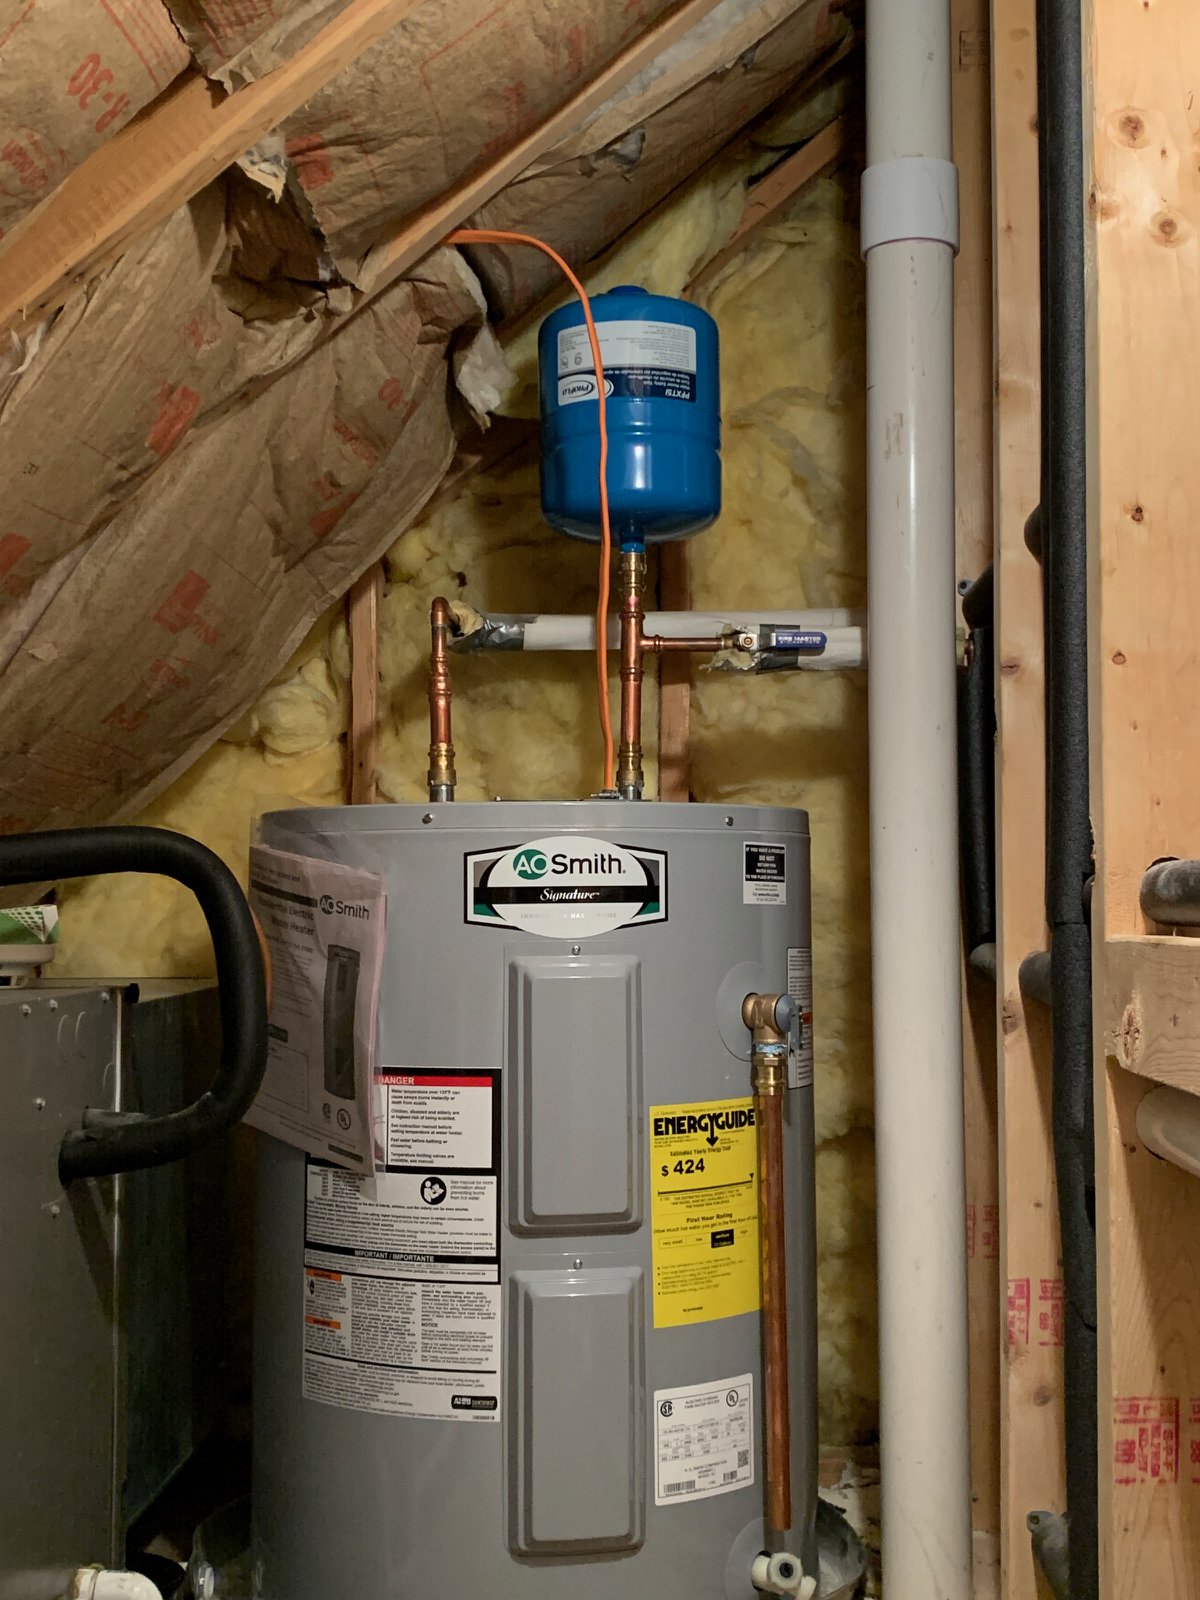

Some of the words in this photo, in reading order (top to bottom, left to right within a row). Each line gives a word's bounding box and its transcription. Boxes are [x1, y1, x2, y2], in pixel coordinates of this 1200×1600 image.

[67, 52, 130, 135] R-30
[662, 1165, 668, 1177] $
[674, 1158, 705, 1175] 424
[354, 1250, 388, 1259] IMPORTANT
